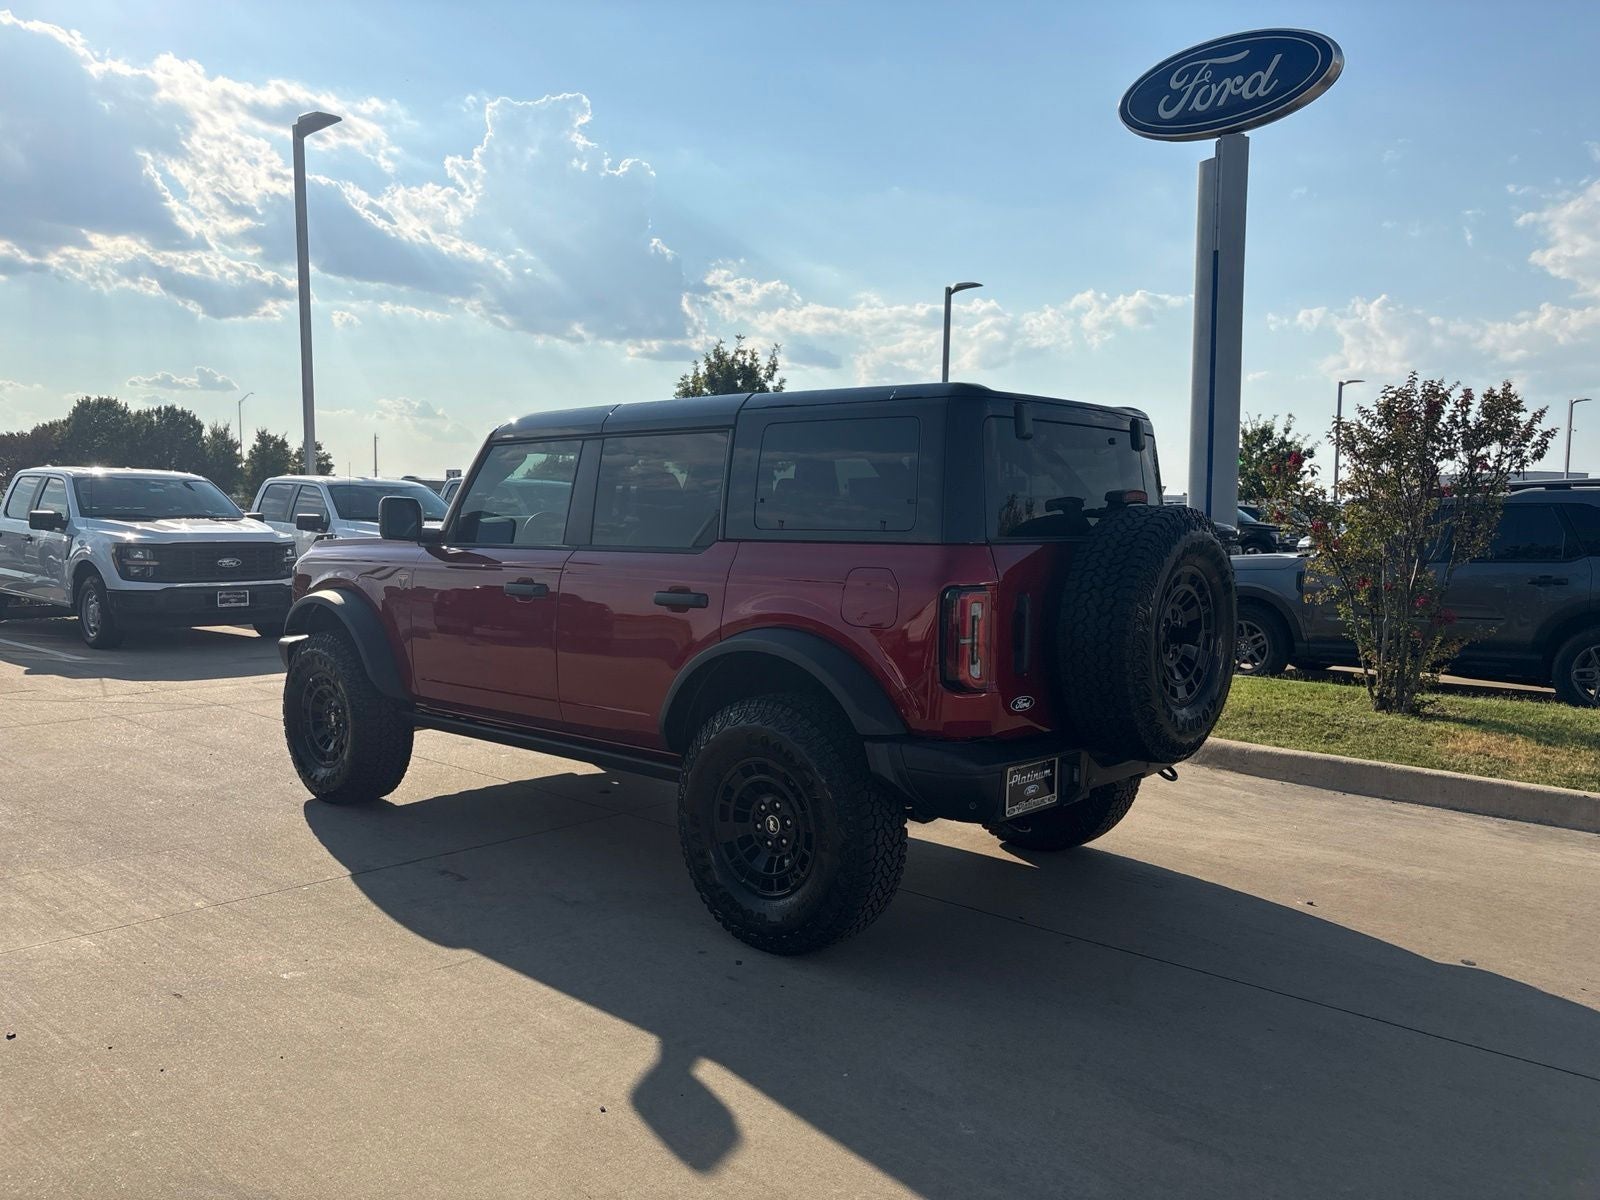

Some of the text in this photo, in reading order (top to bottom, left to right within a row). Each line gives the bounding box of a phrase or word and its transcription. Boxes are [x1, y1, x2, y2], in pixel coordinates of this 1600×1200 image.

[1157, 49, 1282, 119] Ford
[1015, 697, 1031, 709] Ford
[1009, 769, 1052, 787] Platinum
